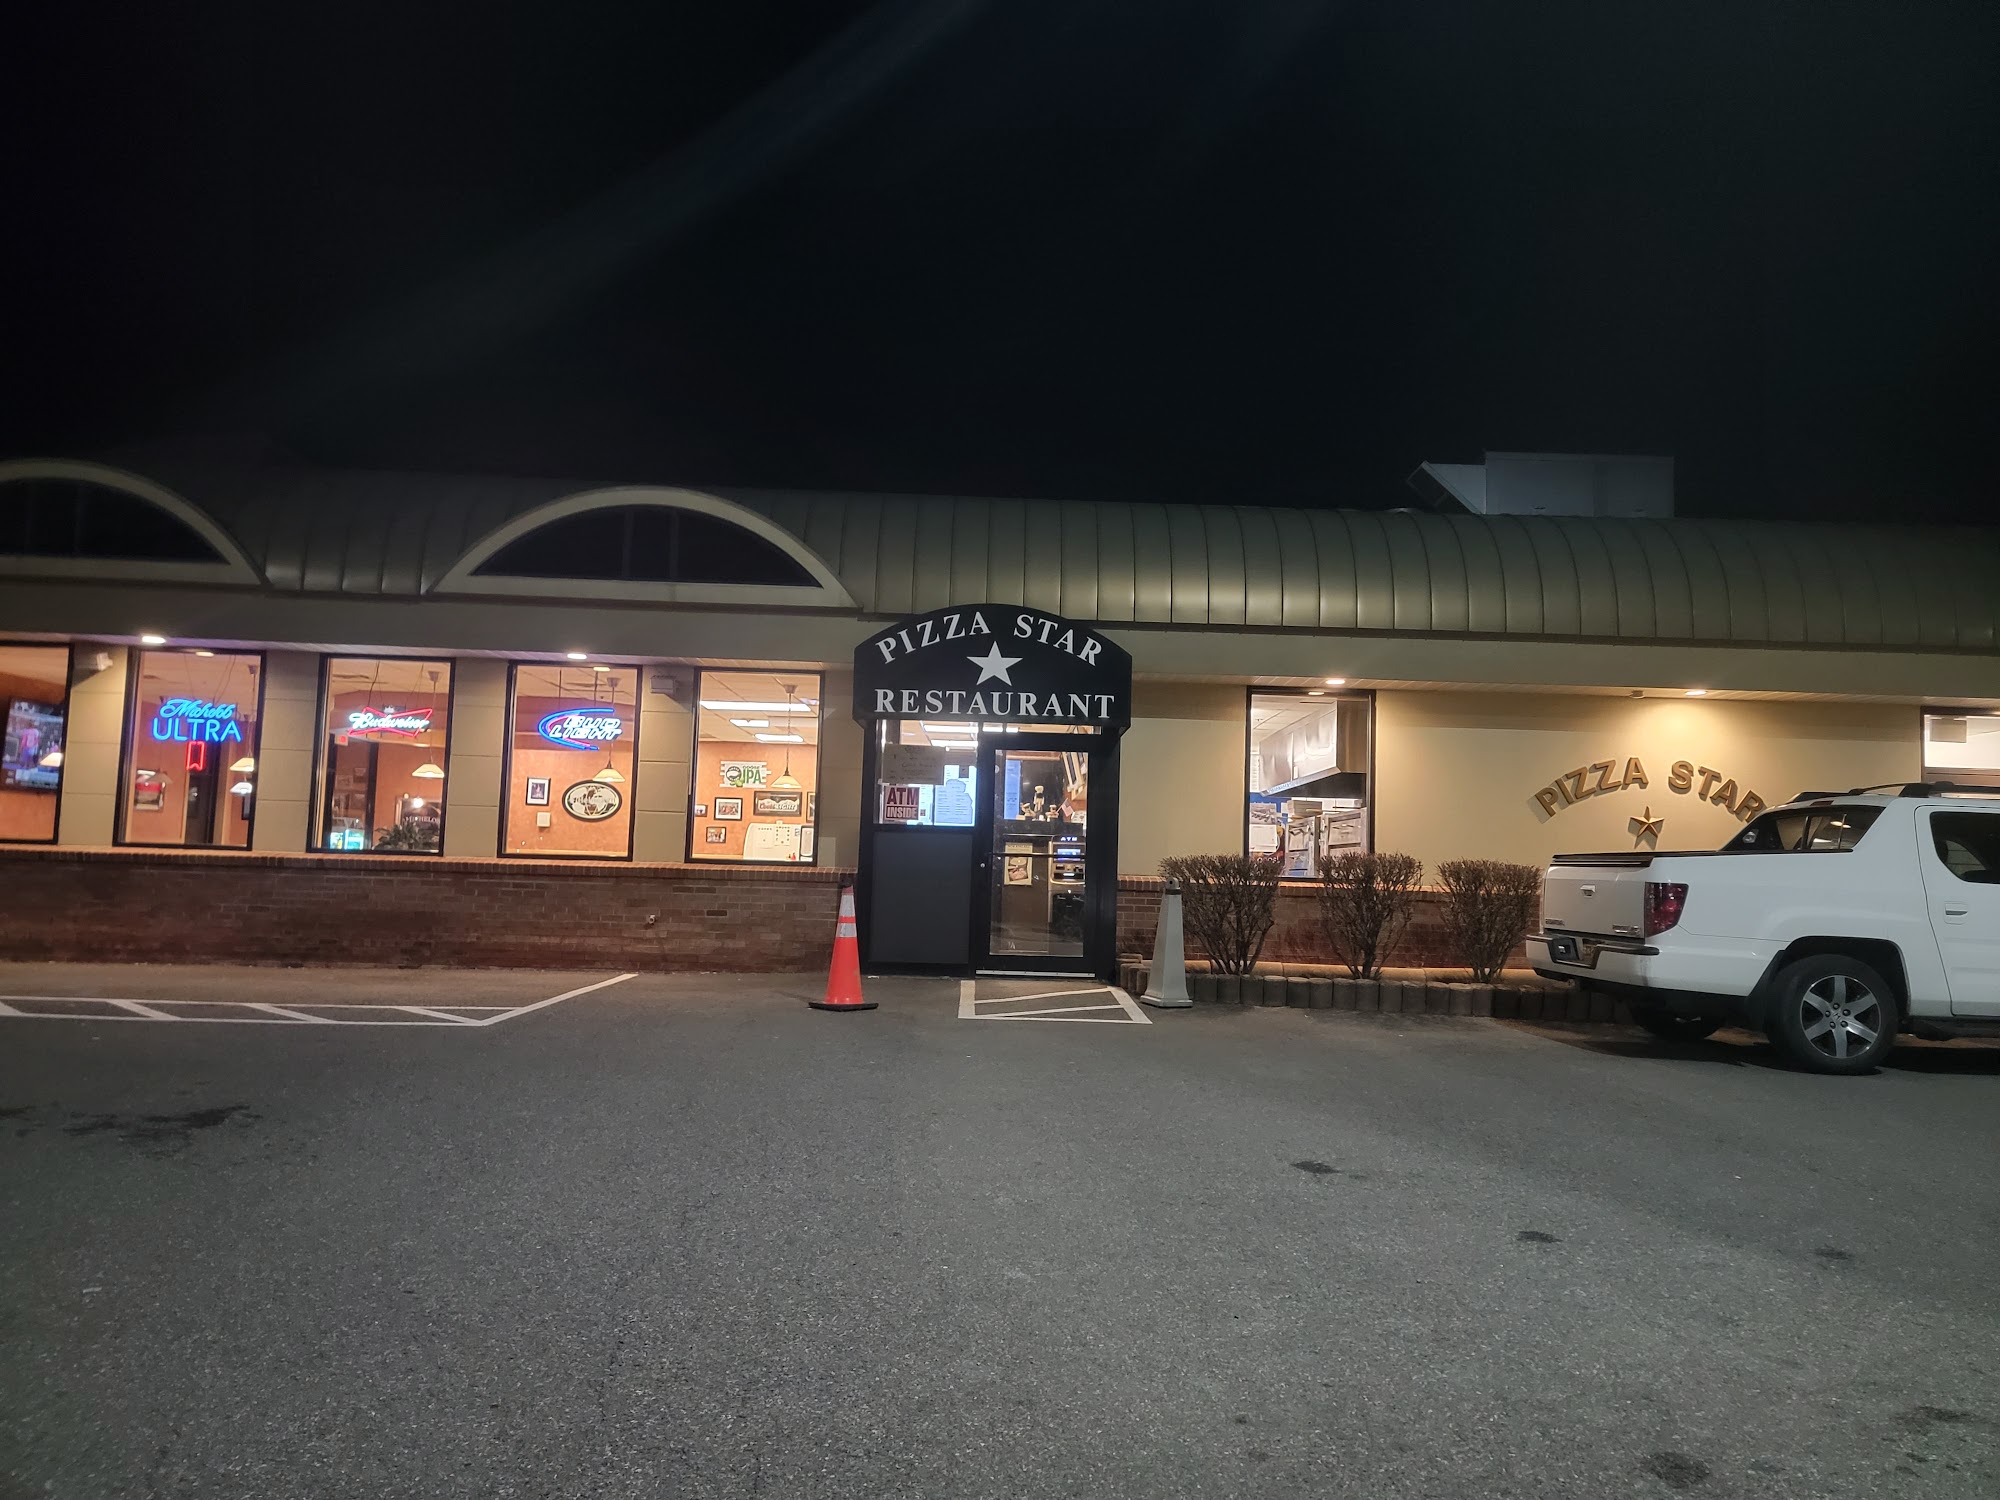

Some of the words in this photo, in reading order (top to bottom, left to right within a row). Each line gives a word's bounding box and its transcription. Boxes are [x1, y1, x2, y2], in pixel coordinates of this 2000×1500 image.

[875, 611, 991, 664] PIZZA
[1013, 614, 1102, 666] STAR
[159, 698, 236, 719] Michelob
[874, 688, 1115, 719] RESTAURANT
[152, 717, 242, 742] ULTRA
[349, 712, 430, 729] Budweiser
[563, 715, 621, 729] BUD
[549, 725, 622, 740] LIGHT
[743, 769, 762, 784] IPA
[887, 787, 918, 805] ATM
[1535, 757, 1649, 817] PIZZA
[1668, 760, 1767, 823] STAR
[887, 807, 917, 818] INSIDE
